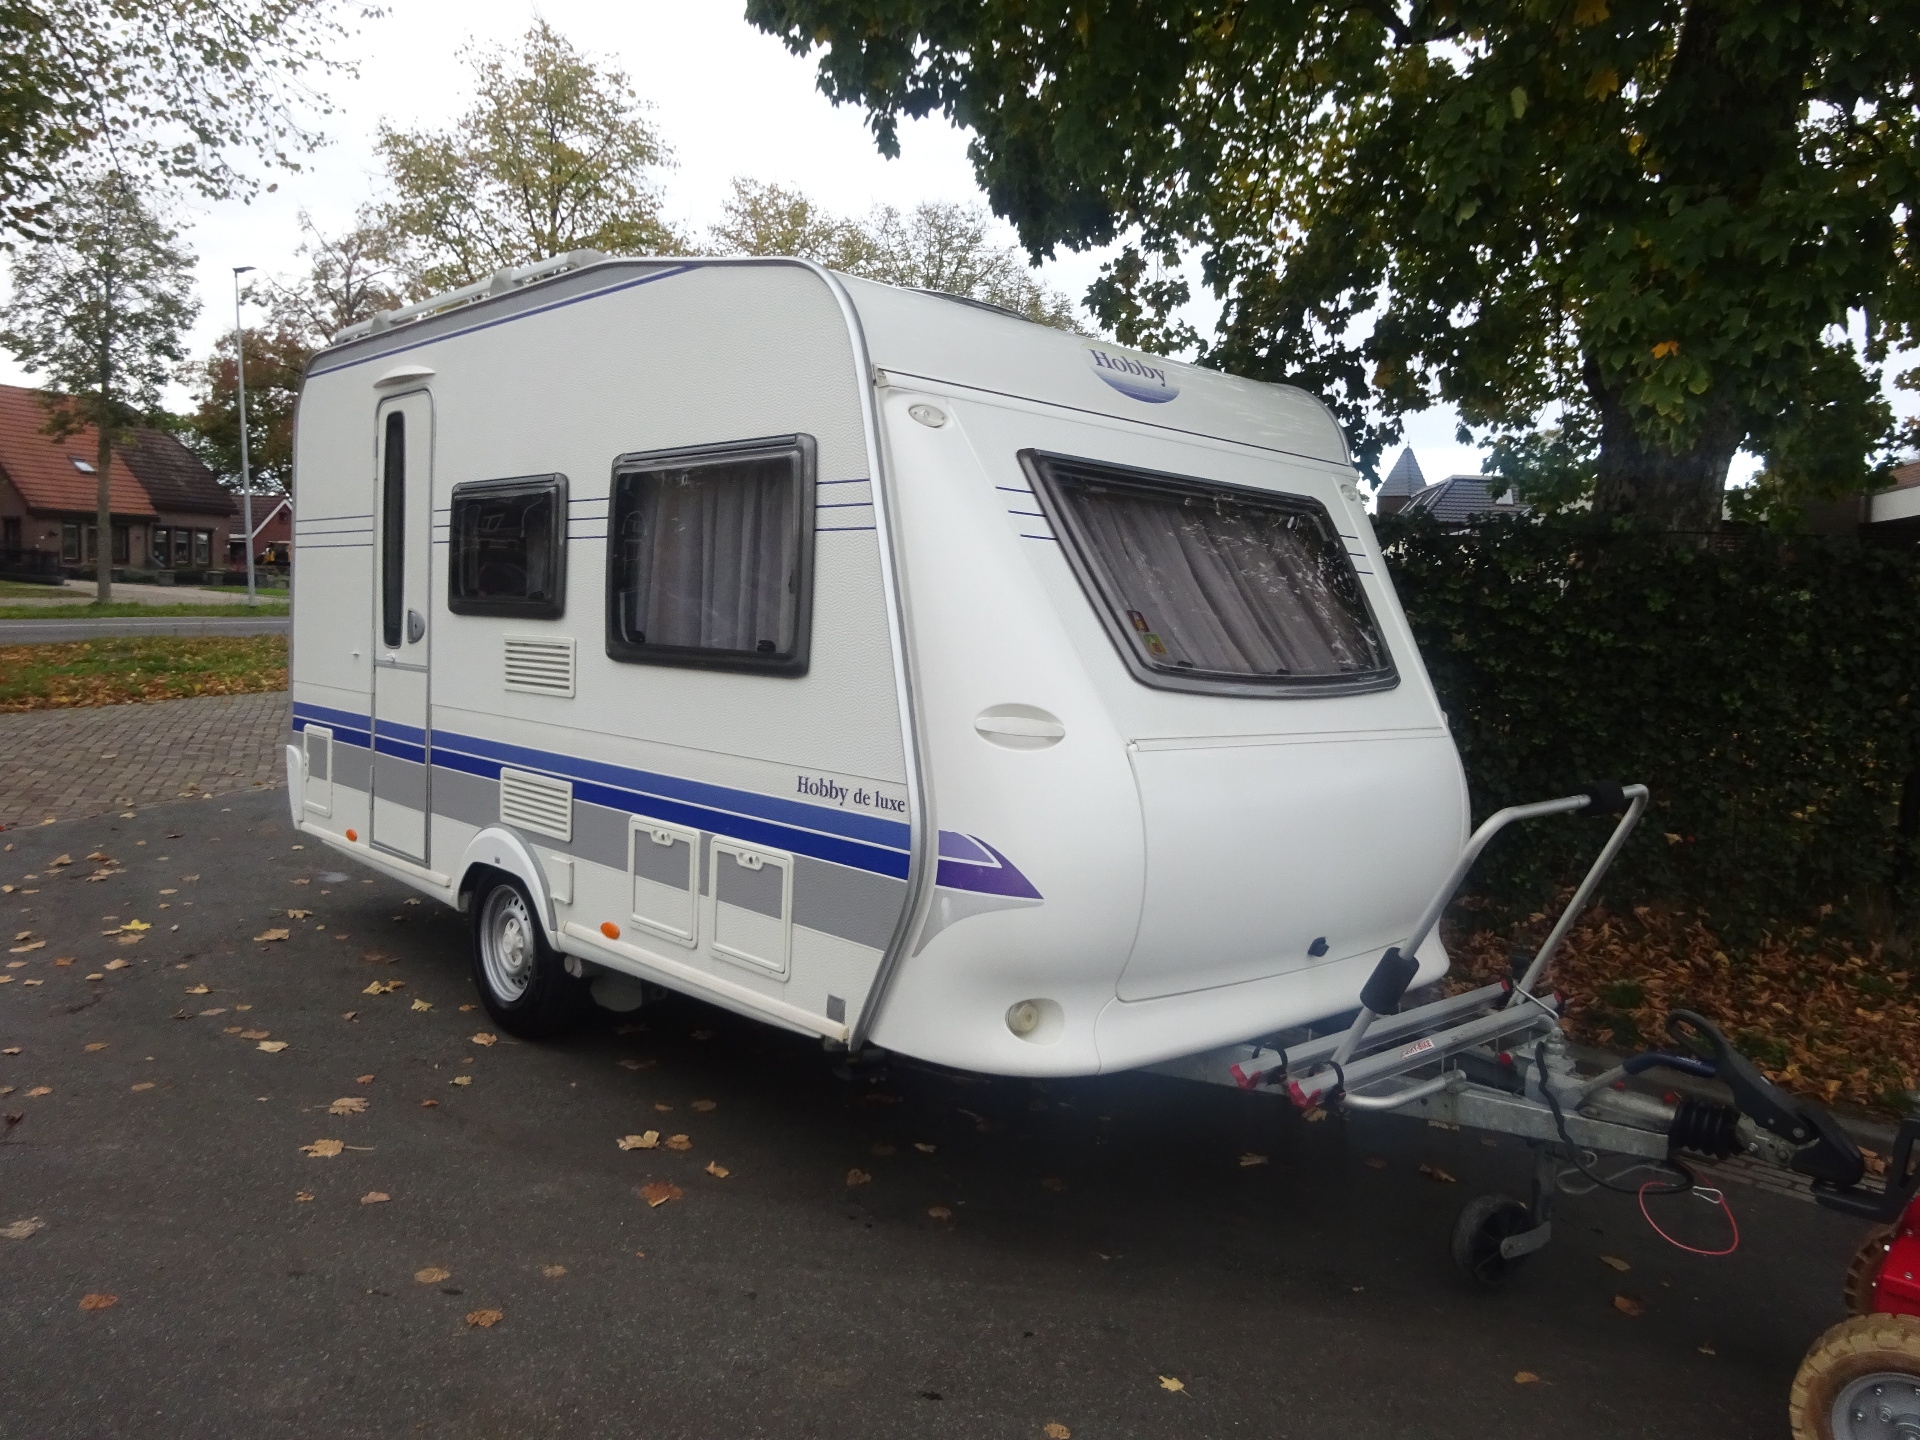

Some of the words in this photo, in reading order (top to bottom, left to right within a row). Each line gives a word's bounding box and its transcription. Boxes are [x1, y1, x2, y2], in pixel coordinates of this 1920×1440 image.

[1088, 349, 1166, 387] Hobby
[797, 775, 848, 806] Hobby
[853, 788, 871, 806] de
[874, 790, 905, 812] luxe
